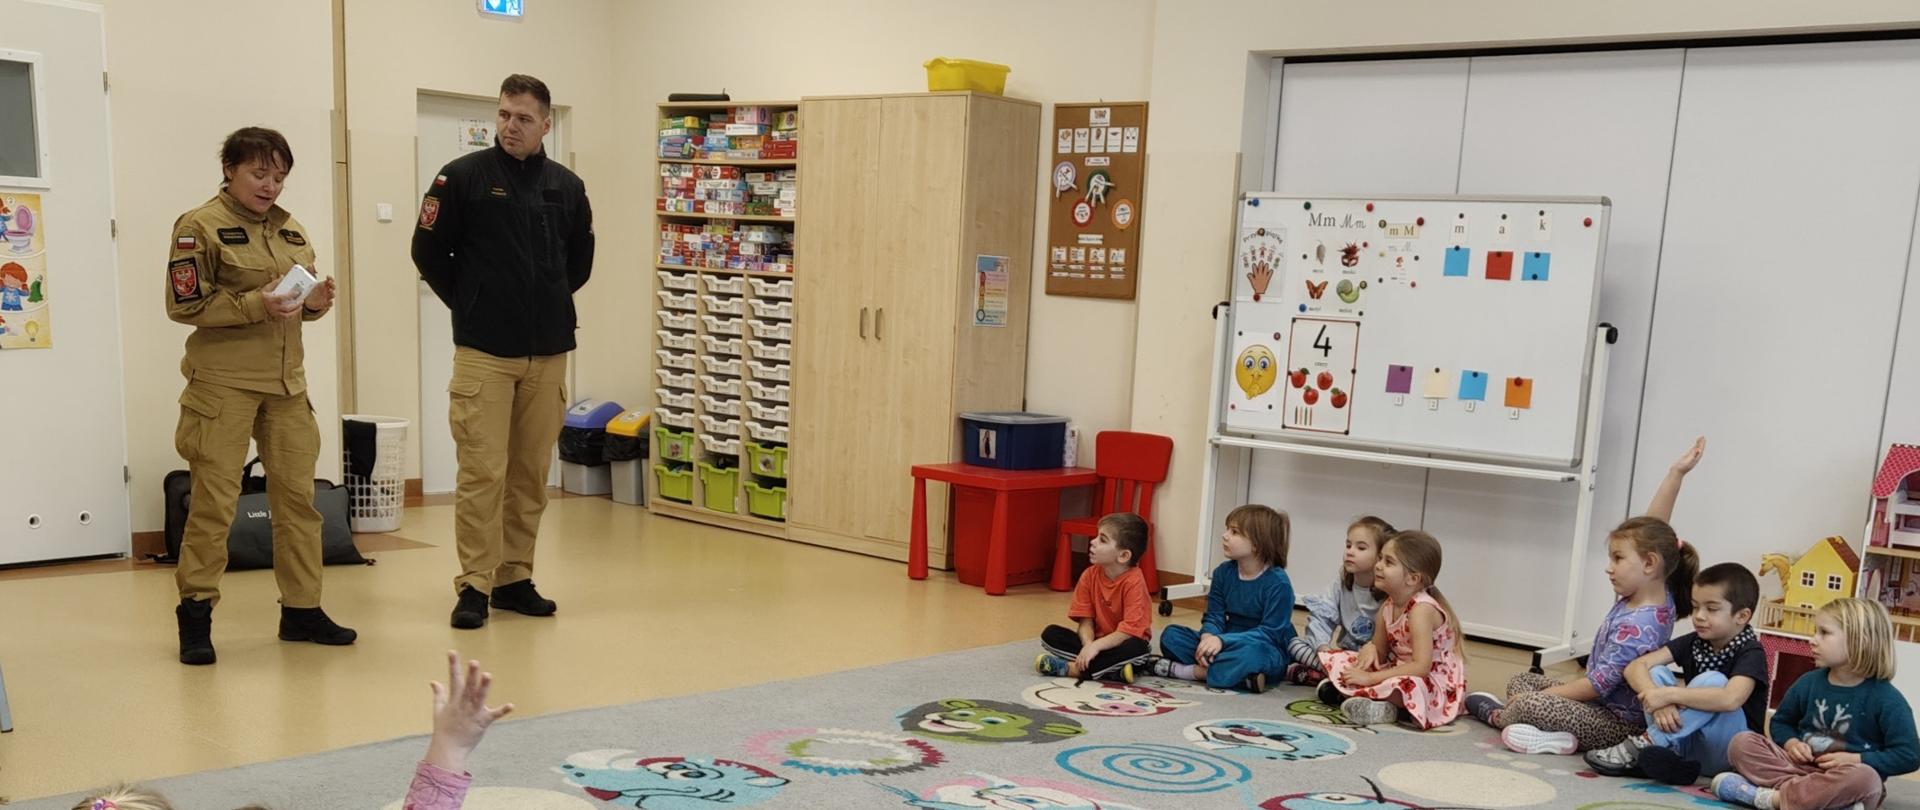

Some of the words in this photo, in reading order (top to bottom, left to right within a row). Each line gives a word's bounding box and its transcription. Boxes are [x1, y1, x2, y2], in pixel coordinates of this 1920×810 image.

[1308, 213, 1336, 227] Mm
[1340, 213, 1366, 229] Mm
[1455, 224, 1465, 234] m
[1499, 225, 1505, 234] a
[1539, 219, 1546, 231] k
[1389, 228, 1399, 236] m
[1403, 225, 1415, 236] M
[1313, 324, 1332, 357] 4
